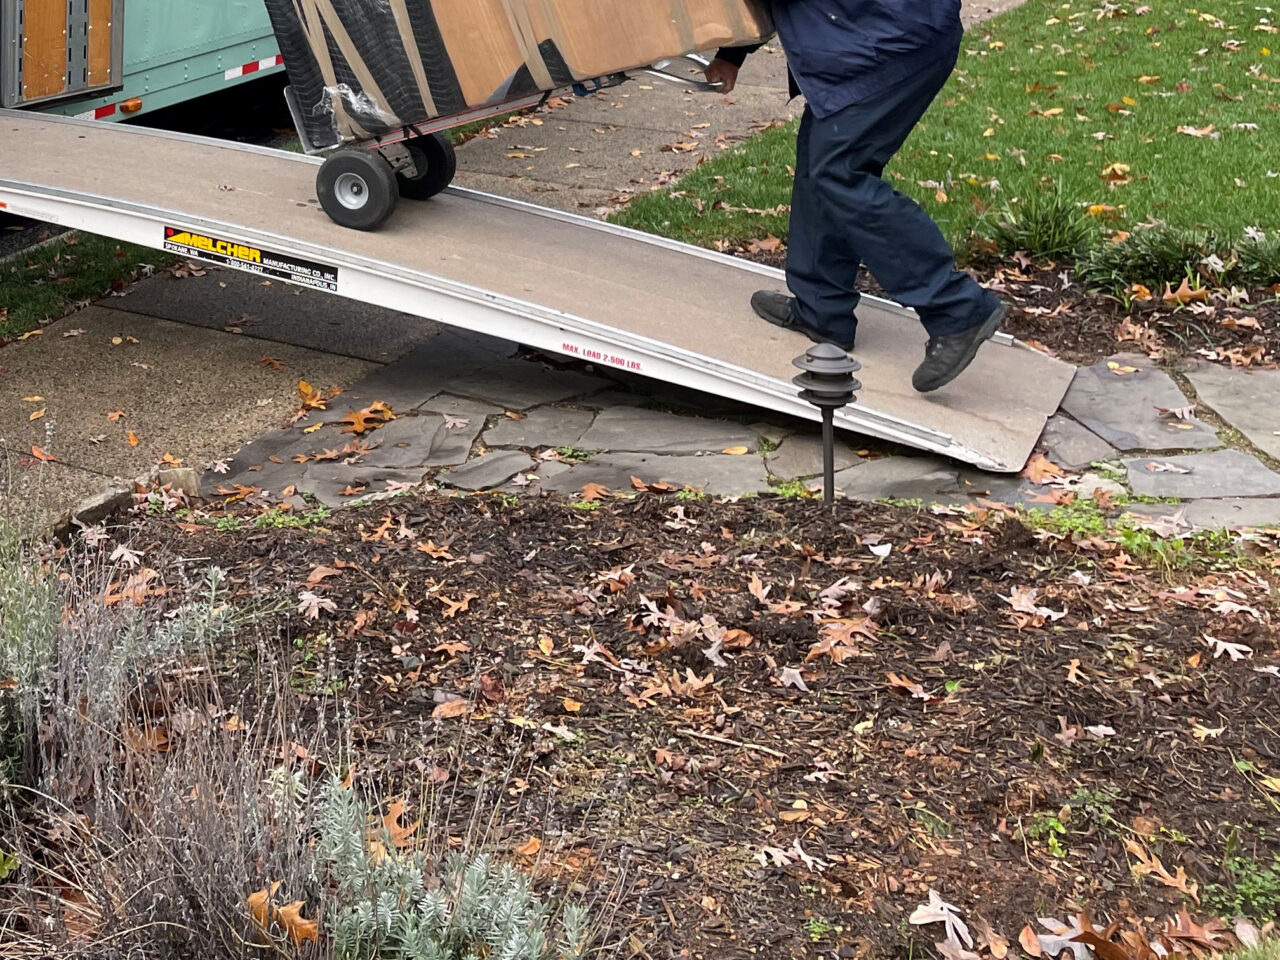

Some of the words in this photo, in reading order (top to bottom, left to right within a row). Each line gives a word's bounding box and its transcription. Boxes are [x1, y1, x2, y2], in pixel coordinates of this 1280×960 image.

[189, 248, 198, 257] WA
[262, 257, 312, 275] MANUFACTURING
[562, 343, 581, 355] MAX.
[582, 348, 601, 360] LOAD
